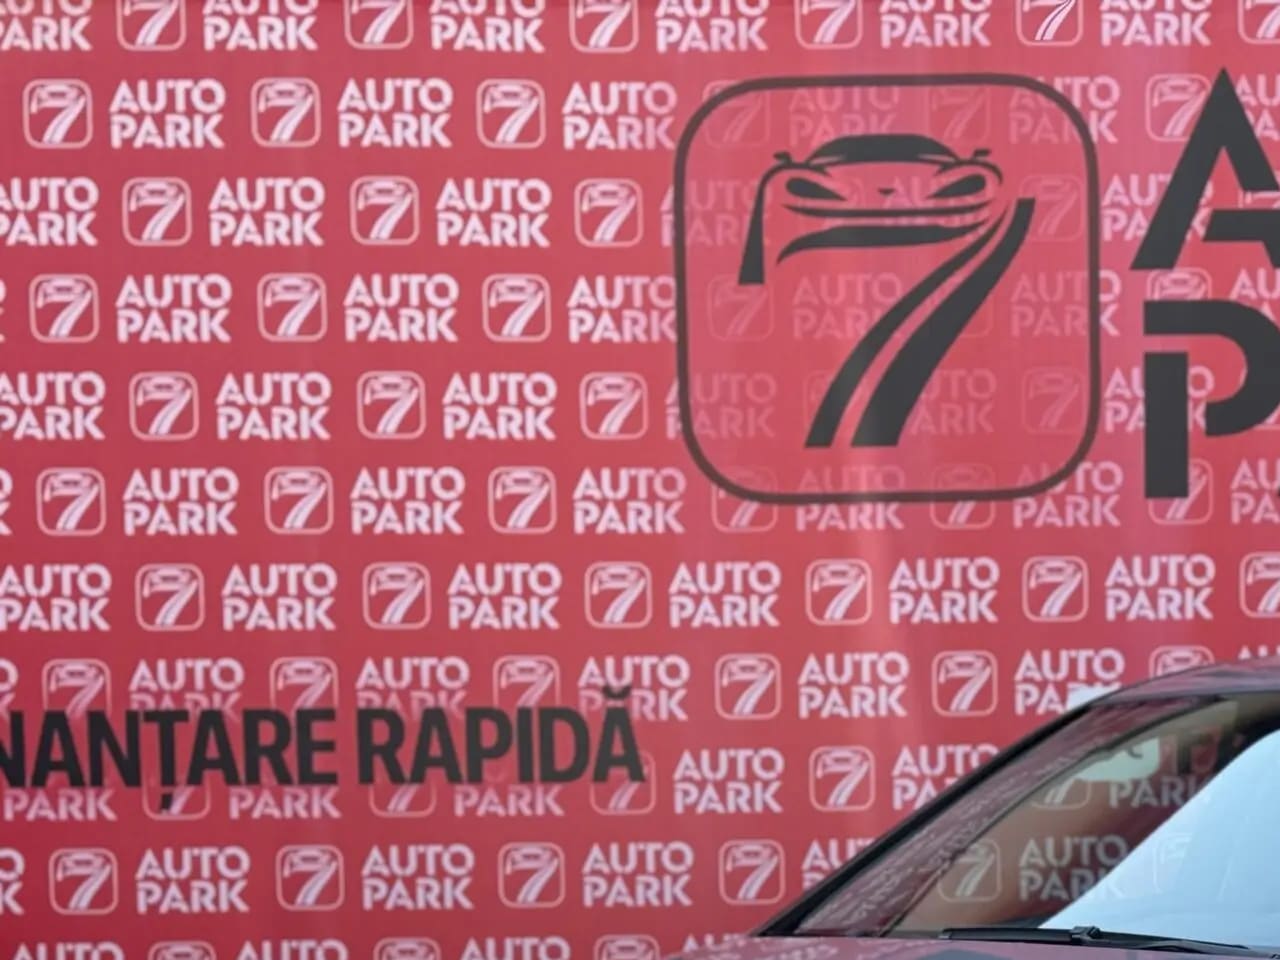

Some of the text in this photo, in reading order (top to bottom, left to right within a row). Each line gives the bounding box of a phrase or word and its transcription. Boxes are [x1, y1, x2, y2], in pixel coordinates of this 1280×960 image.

[204, 16, 318, 51] PARK
[431, 17, 544, 53] PARK
[656, 17, 767, 53] PARK
[881, 13, 990, 48] PARK
[1102, 12, 1210, 47] PARK
[109, 78, 226, 113] AUTO
[337, 78, 453, 112] AUTO
[562, 81, 677, 115] AUTO
[110, 113, 224, 149] PARK
[339, 112, 452, 148] PARK
[563, 115, 676, 150] PARK
[208, 177, 325, 211] AUTO
[436, 178, 552, 211] AUTO
[210, 211, 323, 246] PARK
[437, 211, 550, 248] PARK
[115, 274, 232, 307] AUTO
[343, 273, 459, 307] AUTO
[567, 275, 676, 308] AUTO
[117, 307, 231, 343] PARK
[345, 307, 458, 342] PARK
[569, 308, 677, 343] PARK
[0, 371, 106, 405] AUTO
[216, 372, 332, 405] AUTO
[442, 372, 557, 405] AUTO
[0, 405, 105, 440] PARK
[217, 405, 330, 440] PARK
[444, 405, 555, 440] PARK
[123, 467, 239, 501] AUTO
[350, 467, 465, 500] AUTO
[573, 467, 686, 500] AUTO
[124, 501, 237, 536] PARK
[351, 500, 463, 534] PARK
[574, 500, 684, 534] PARK
[796, 501, 904, 532] PARK
[1013, 493, 1121, 529] PARK
[0, 563, 112, 597] AUTO
[222, 563, 337, 596] AUTO
[448, 563, 562, 595] AUTO
[669, 561, 781, 594] AUTO
[888, 557, 1000, 590] AUTO
[1105, 554, 1215, 586] AUTO
[0, 597, 110, 632] PARK
[223, 596, 335, 631] PARK
[449, 595, 559, 629] PARK
[670, 594, 779, 628] PARK
[889, 590, 997, 624] PARK
[1106, 586, 1213, 621] PARK
[129, 658, 244, 691] AUTO
[355, 656, 469, 689] AUTO
[578, 655, 690, 687] AUTO
[798, 651, 909, 684] AUTO
[1014, 648, 1125, 682] AUTO
[799, 684, 907, 718] PARK
[357, 684, 646, 785] RAPIDĂ
[673, 748, 784, 780] AUTO
[4, 787, 117, 821] PARK
[229, 785, 341, 820] PARK
[454, 784, 564, 817] PARK
[674, 780, 782, 814] PARK
[135, 846, 250, 879] AUTO
[362, 844, 474, 876] AUTO
[582, 841, 694, 874] AUTO
[1018, 835, 1128, 869] AUTO
[136, 879, 249, 914] PARK
[363, 876, 473, 910] PARK
[584, 874, 692, 907] PARK
